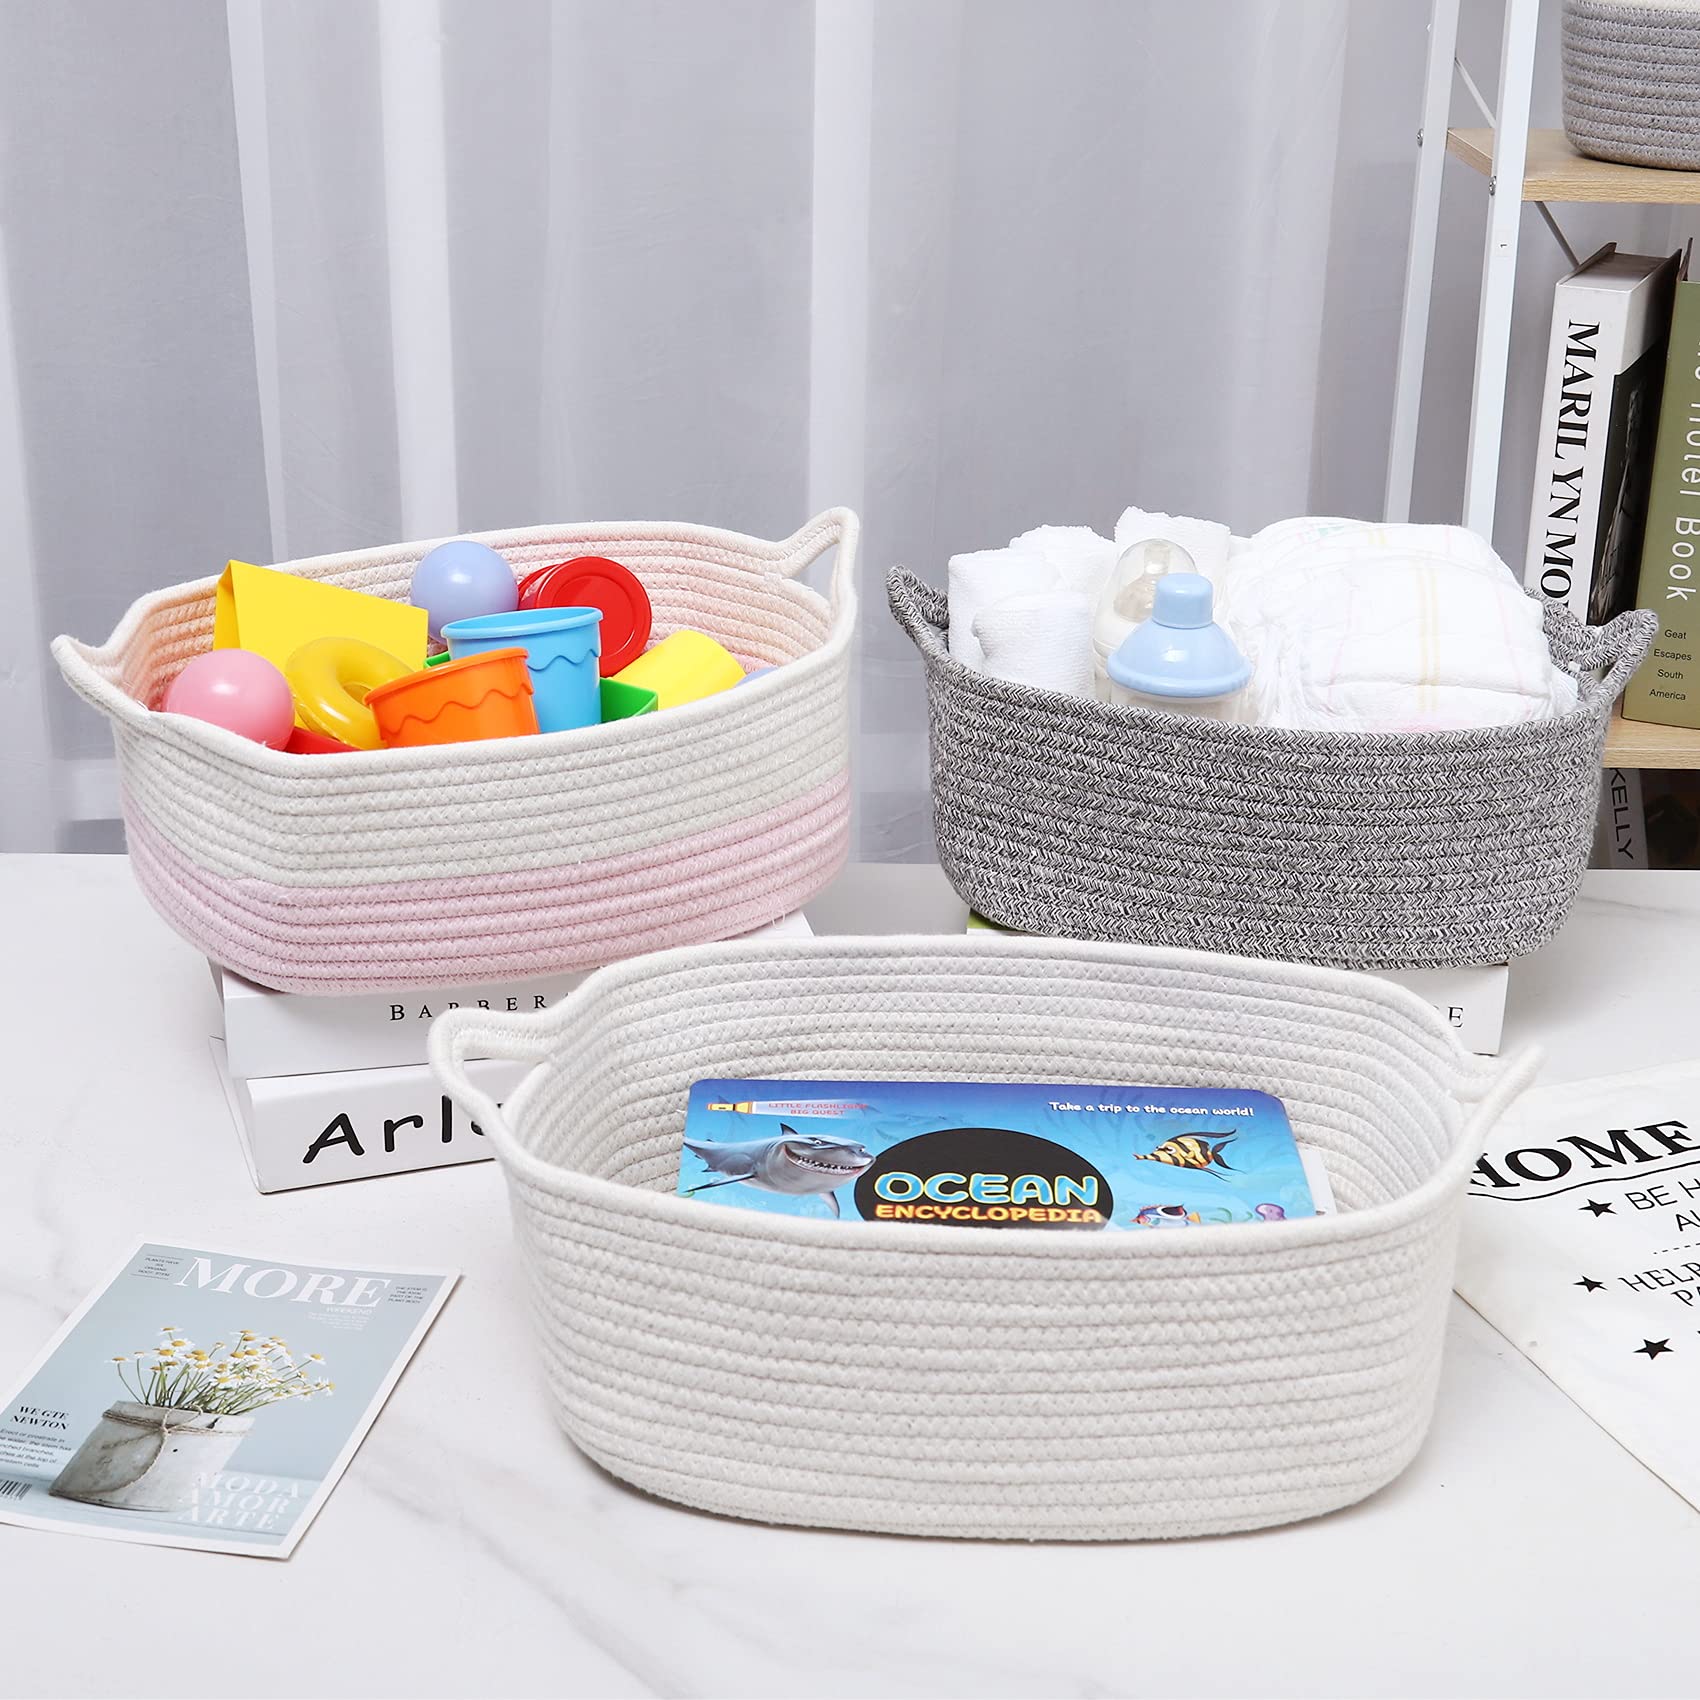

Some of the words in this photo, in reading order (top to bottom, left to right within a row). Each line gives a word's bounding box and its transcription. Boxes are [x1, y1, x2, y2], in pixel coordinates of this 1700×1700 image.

[1540, 528, 1578, 608] MO
[1665, 516, 1700, 601] Book
[1664, 629, 1687, 640] Geat
[1653, 648, 1693, 661] Escapes
[1657, 668, 1684, 680] South
[1649, 688, 1687, 701] America
[1609, 768, 1634, 860] KELLY
[1049, 1101, 1082, 1111] Take
[1086, 1104, 1095, 1112] a
[1098, 1104, 1122, 1114] trip
[1126, 1104, 1140, 1113] to
[1144, 1104, 1166, 1114] the
[1170, 1107, 1208, 1115] ocean
[1212, 1107, 1255, 1117] world!
[302, 1094, 503, 1164] Arl
[874, 1171, 1099, 1207] OCEAN
[1624, 1185, 1678, 1211] BE
[875, 1204, 1102, 1223] ENCYCLOPEDIA
[173, 1256, 392, 1308] MORE
[10, 1415, 70, 1430] NEWTON
[20, 1406, 41, 1416] WE
[41, 1409, 70, 1420] GTE
[190, 1472, 300, 1498] MODA
[178, 1486, 291, 1514] AMOR
[177, 1504, 280, 1530] ARTE
